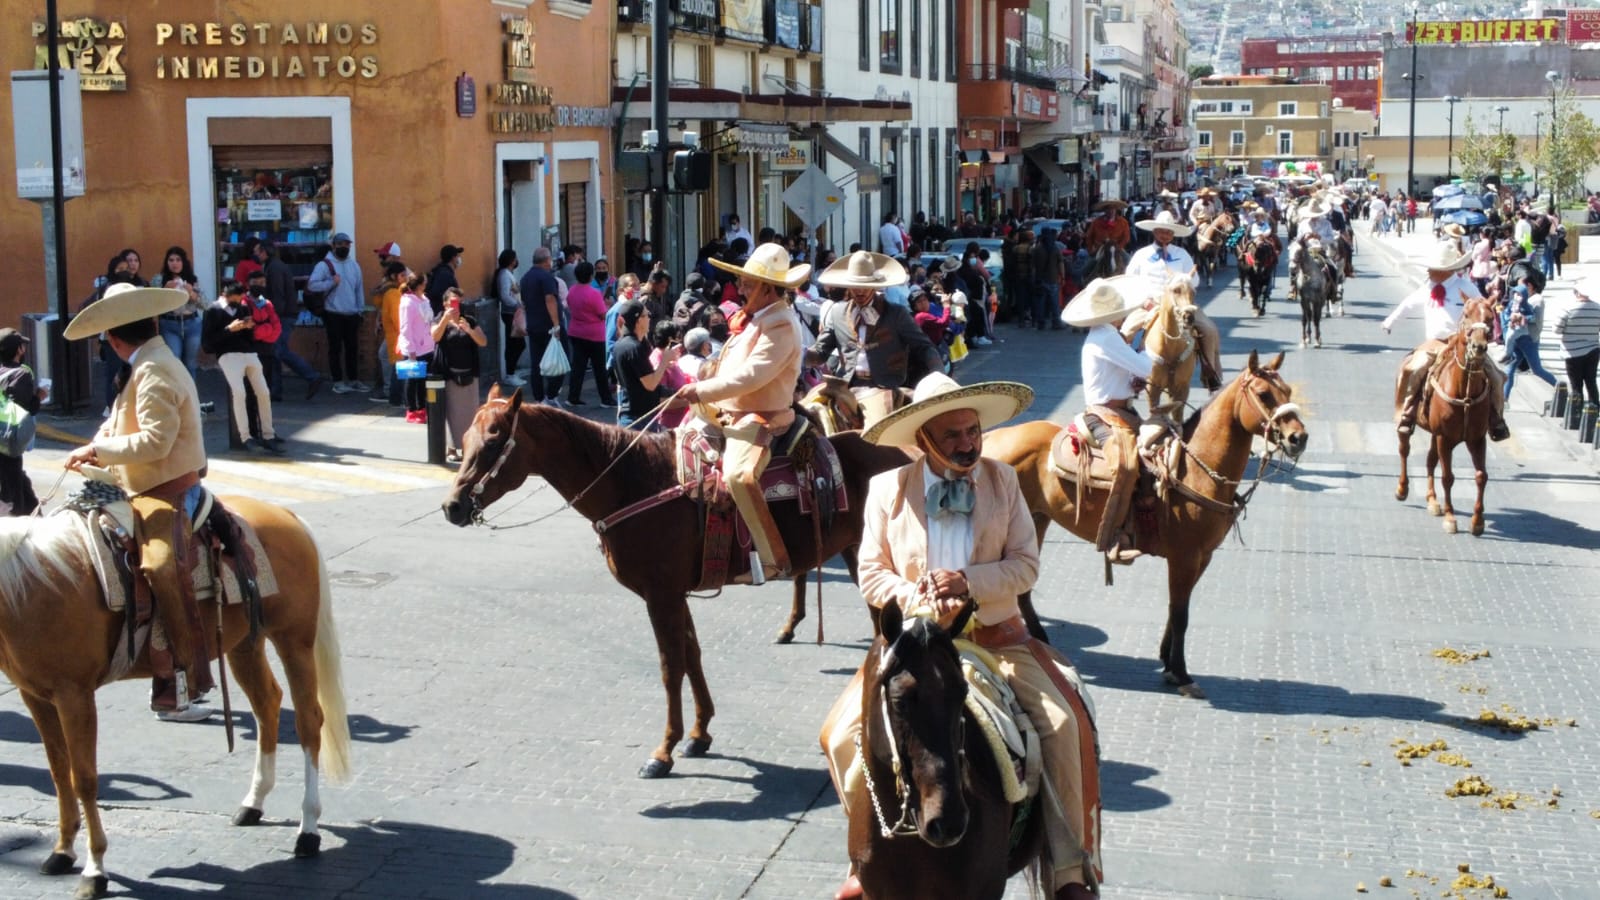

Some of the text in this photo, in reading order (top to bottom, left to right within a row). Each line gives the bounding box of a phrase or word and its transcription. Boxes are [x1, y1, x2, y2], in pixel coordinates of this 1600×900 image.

[1573, 13, 1600, 21] DES
[32, 21, 125, 38] PENDA
[156, 22, 379, 46] PRESTAMOS
[1460, 19, 1556, 42] BUFFET
[35, 43, 126, 74] MEX
[156, 55, 379, 79] INMEDIATOS
